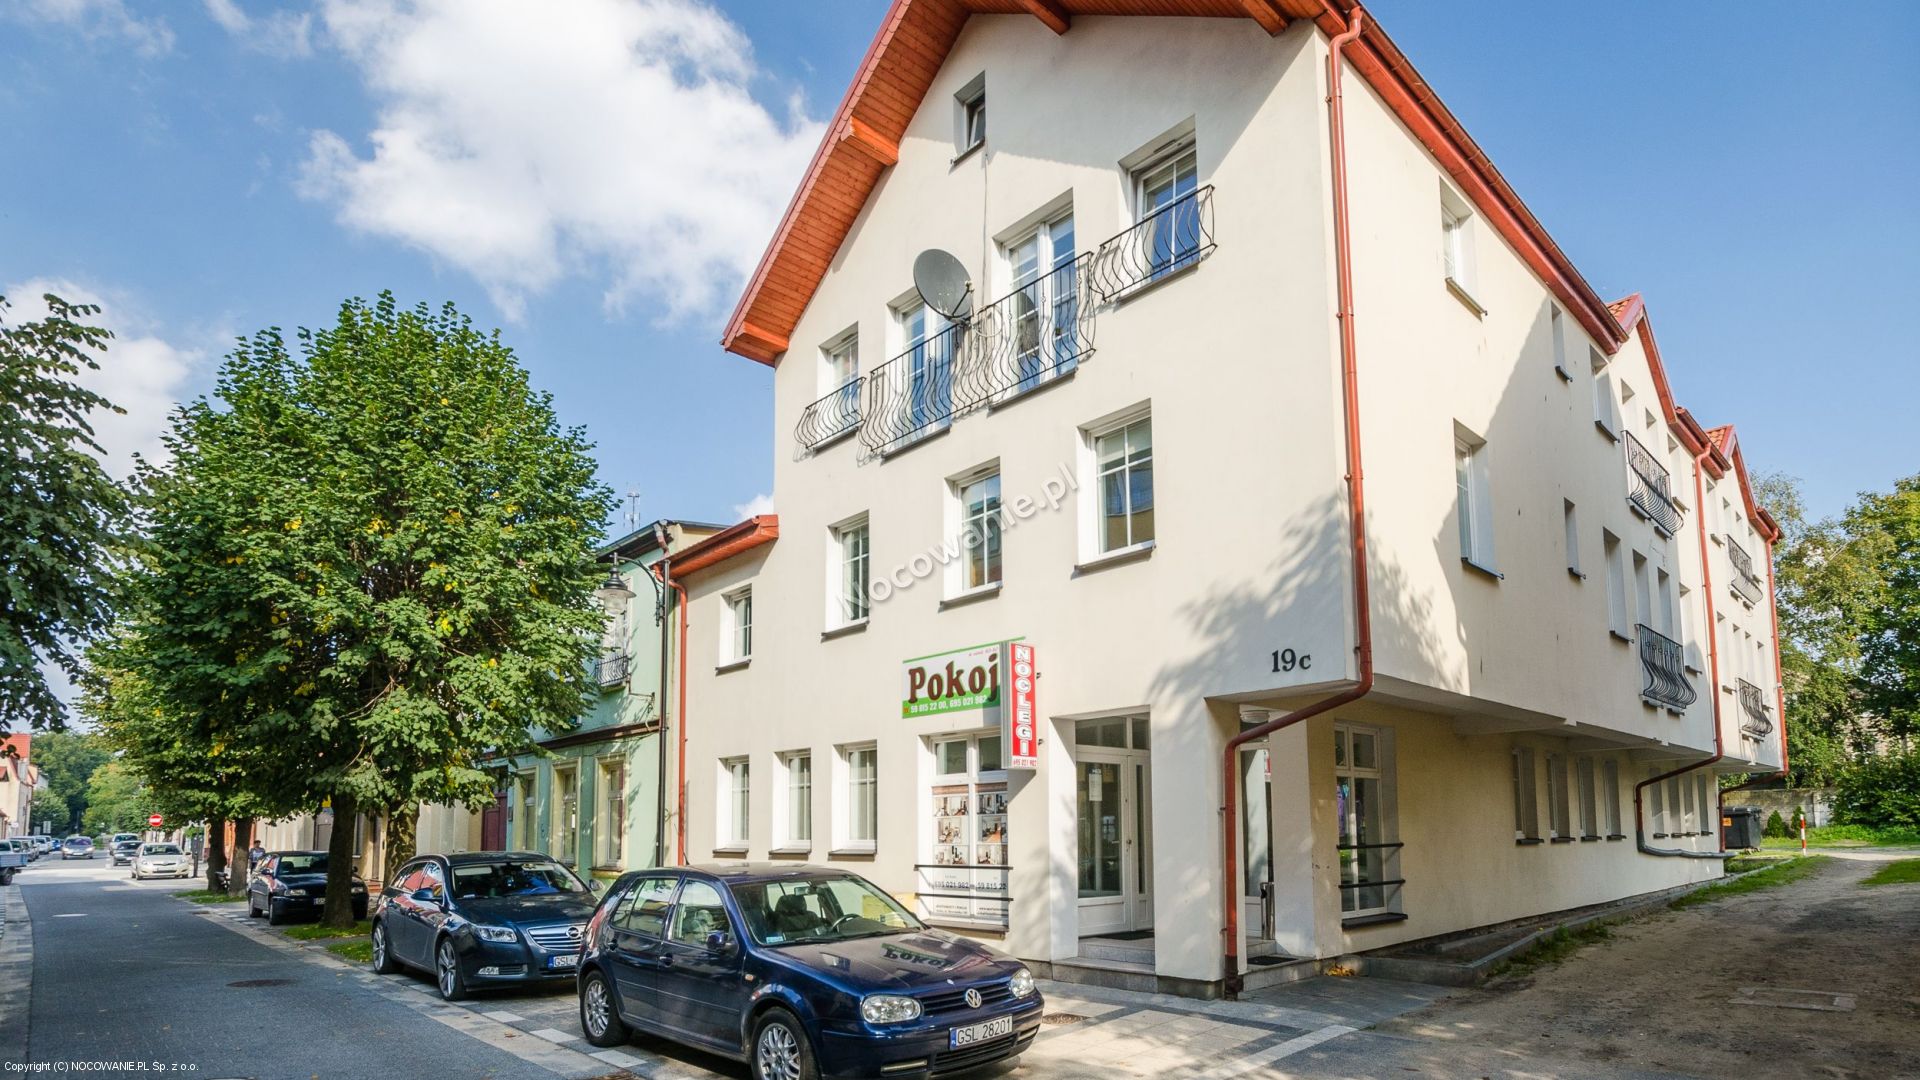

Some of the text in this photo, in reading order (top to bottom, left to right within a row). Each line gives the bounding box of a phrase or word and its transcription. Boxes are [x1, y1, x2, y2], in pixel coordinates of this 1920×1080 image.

[1271, 648, 1311, 673] 19c
[929, 702, 938, 711] 22
[962, 697, 974, 706] 021
[1014, 645, 1032, 756] NOCLEGI
[957, 1018, 1010, 1044] GSL 28201
